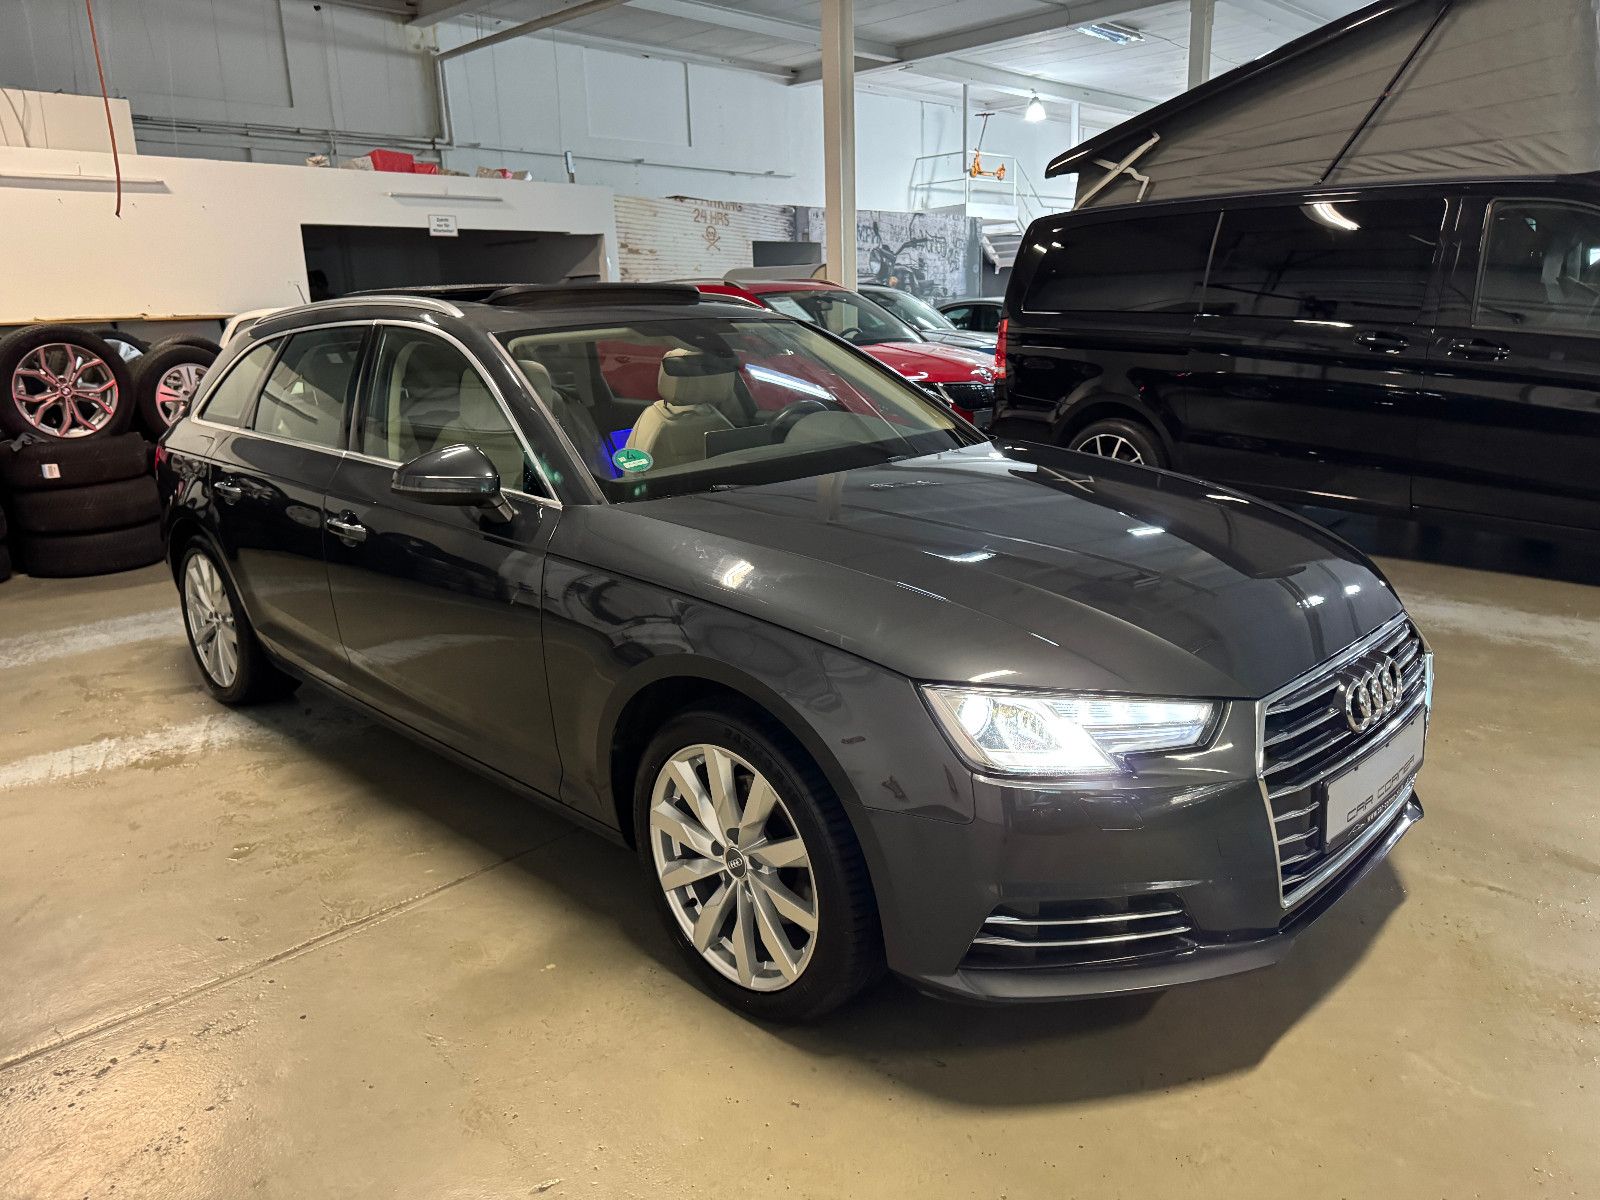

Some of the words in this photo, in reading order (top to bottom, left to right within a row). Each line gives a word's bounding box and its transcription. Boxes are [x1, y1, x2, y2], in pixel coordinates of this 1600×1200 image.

[693, 208, 708, 223] 24
[710, 209, 730, 226] HRS
[1347, 795, 1374, 822] CAR
